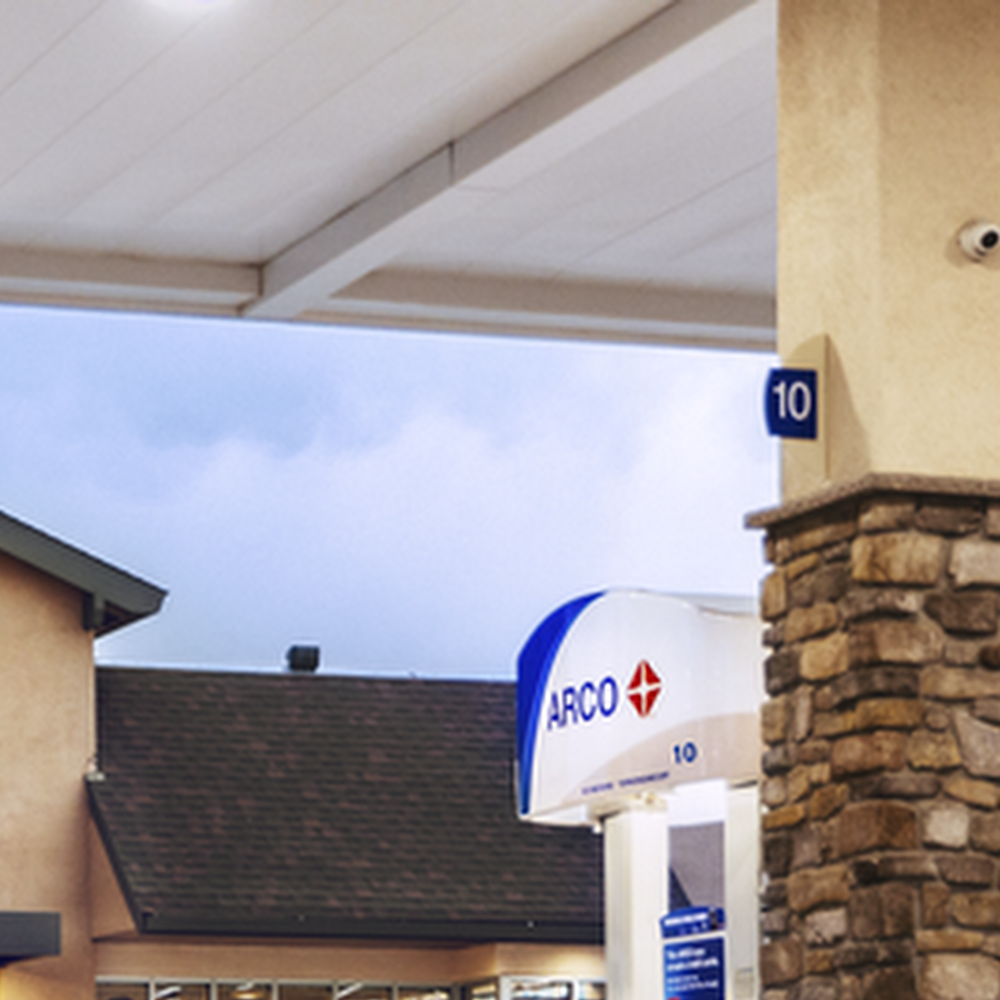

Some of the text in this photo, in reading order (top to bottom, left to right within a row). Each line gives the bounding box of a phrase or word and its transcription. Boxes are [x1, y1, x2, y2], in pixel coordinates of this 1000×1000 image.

[773, 381, 811, 421] 10
[547, 676, 619, 731] ARCO
[673, 741, 698, 764] 10
